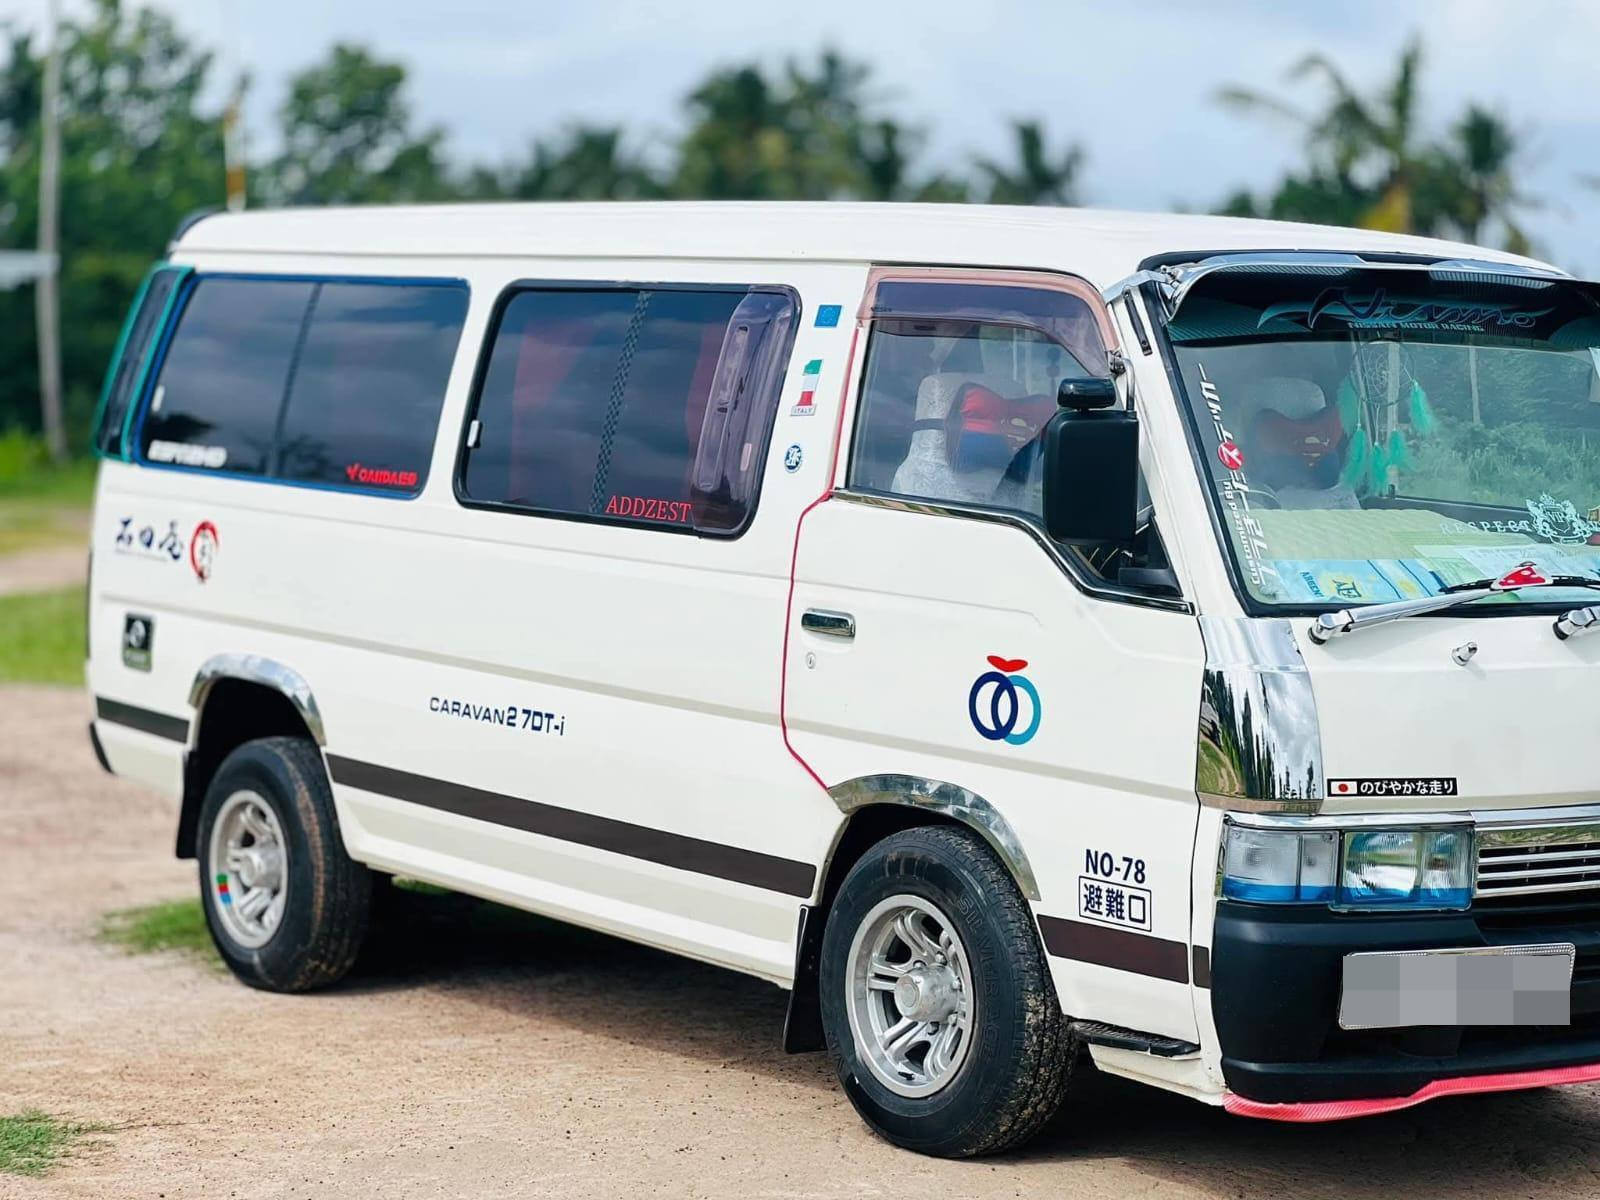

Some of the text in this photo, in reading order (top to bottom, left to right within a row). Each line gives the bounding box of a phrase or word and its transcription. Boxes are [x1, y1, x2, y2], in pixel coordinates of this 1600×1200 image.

[605, 495, 692, 523] ADDZEST
[1440, 520, 1533, 534] RESPECT
[1360, 780, 1453, 795] のびやかな走り
[1085, 848, 1146, 884] NO-78
[1083, 883, 1146, 924] 避難口
